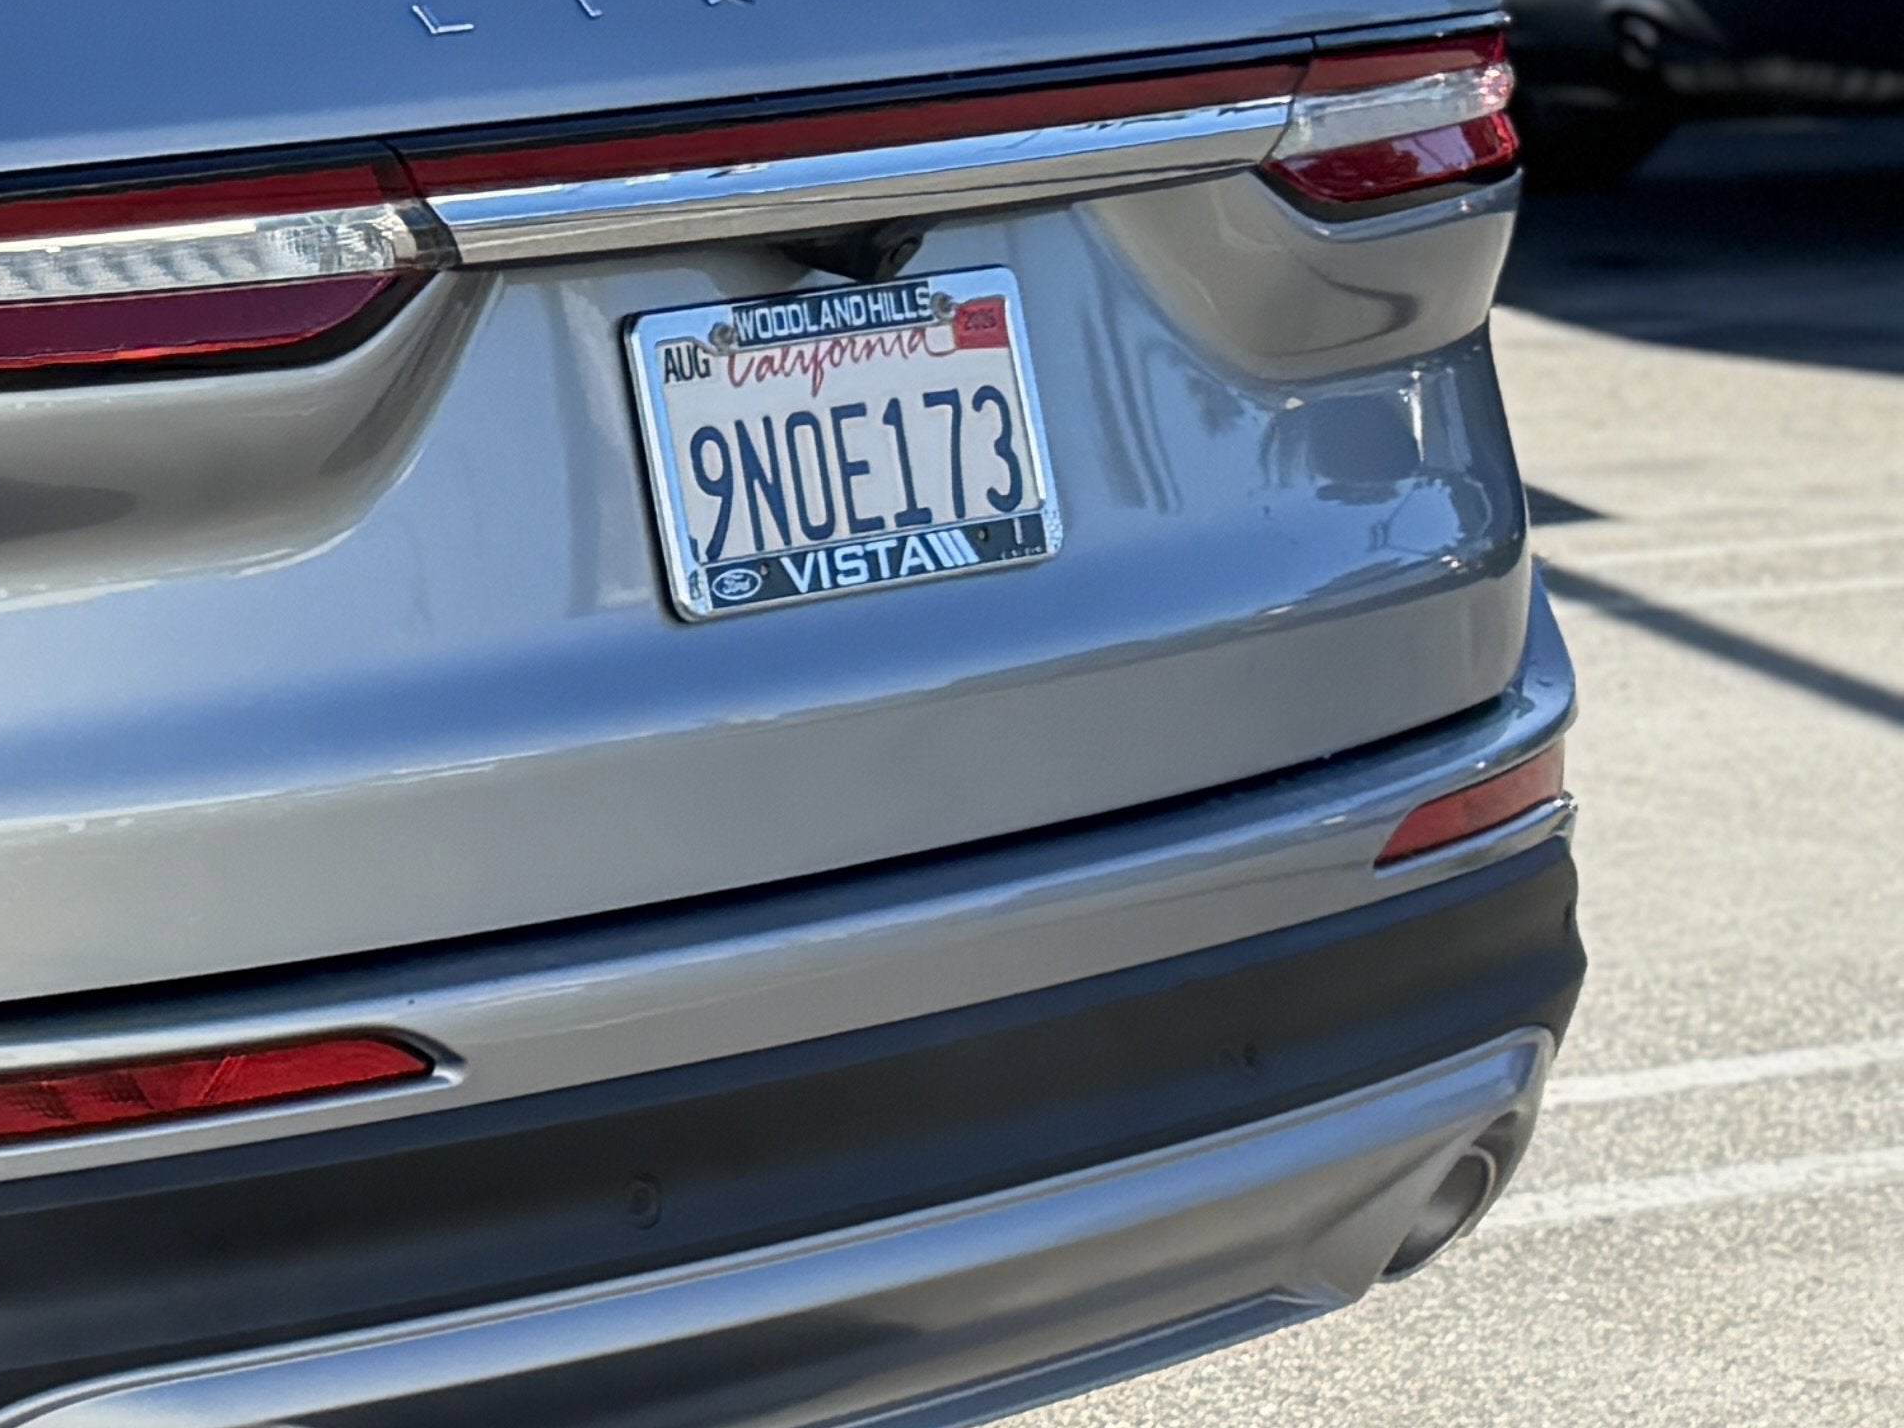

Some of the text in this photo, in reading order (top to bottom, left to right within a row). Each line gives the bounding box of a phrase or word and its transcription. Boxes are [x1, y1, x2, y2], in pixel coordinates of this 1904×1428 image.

[735, 287, 930, 342] WOODLAND HILLS
[664, 346, 711, 384] AUG
[728, 327, 930, 397] California
[689, 385, 1024, 562] 9NOE173
[781, 535, 937, 594] VISTA
